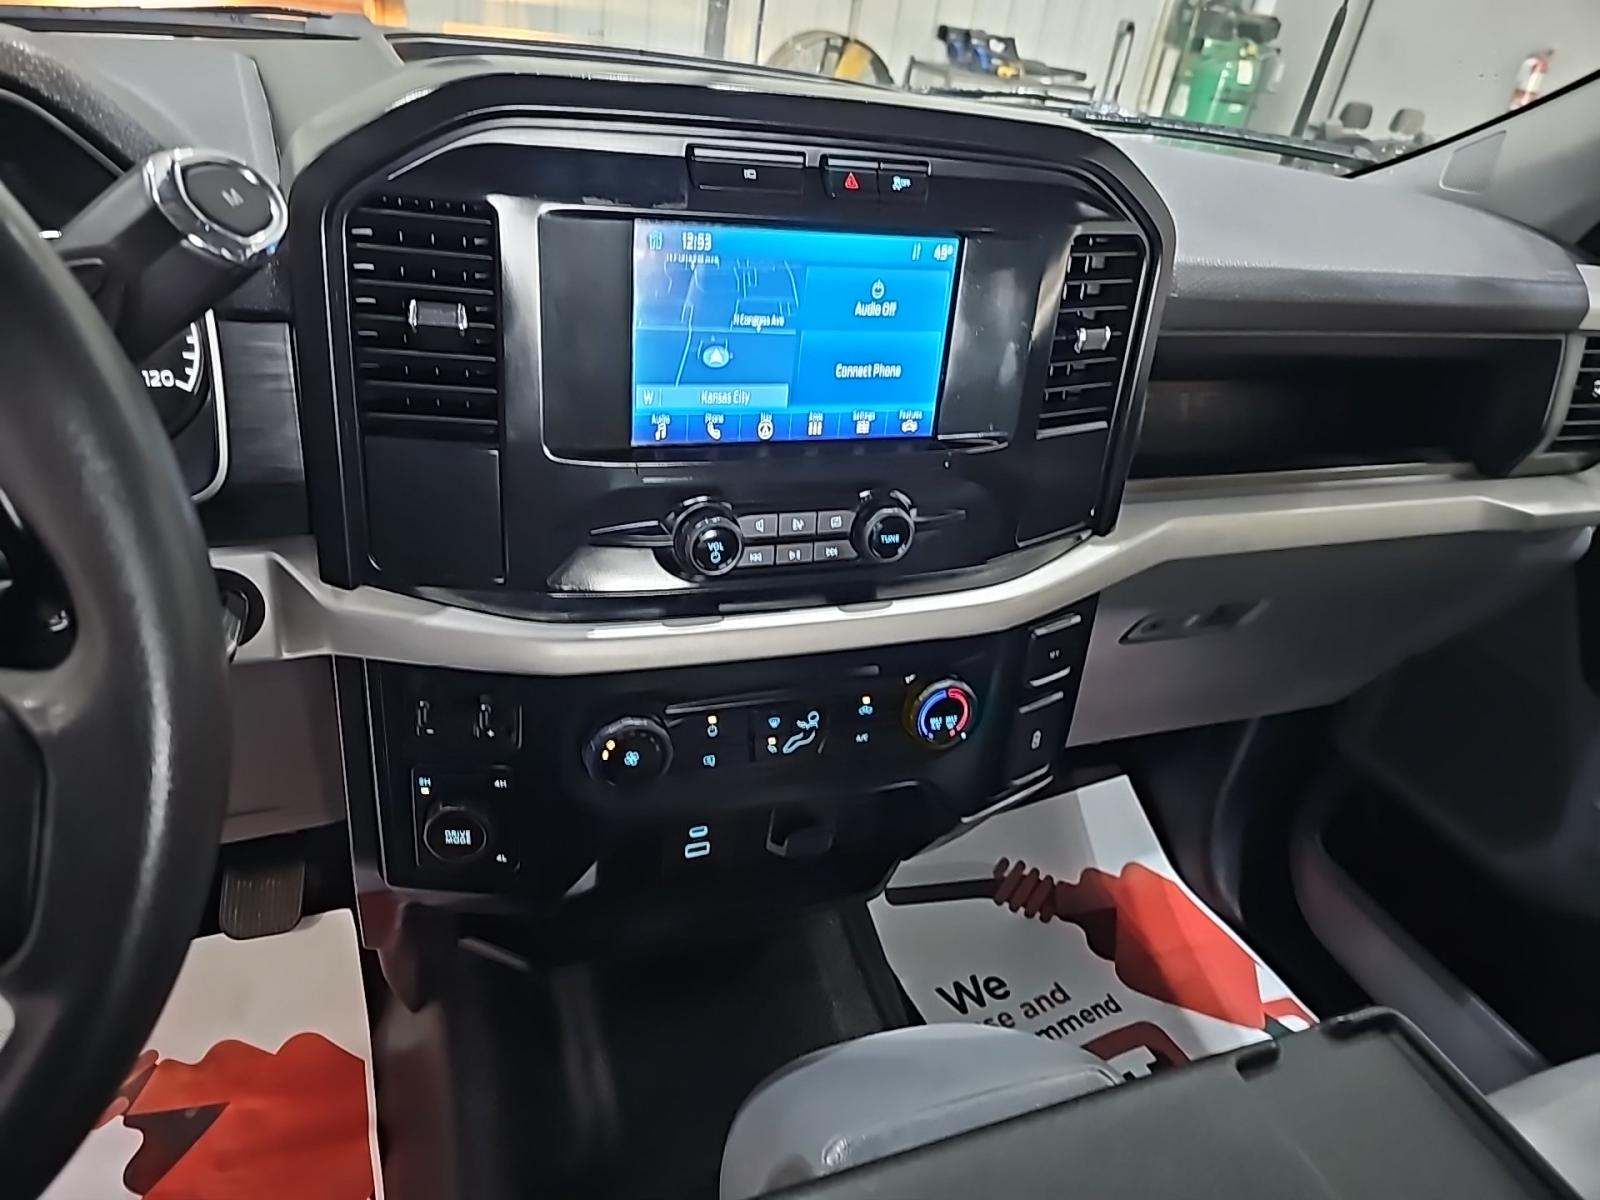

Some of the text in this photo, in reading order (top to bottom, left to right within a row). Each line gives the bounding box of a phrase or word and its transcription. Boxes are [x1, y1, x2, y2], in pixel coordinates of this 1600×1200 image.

[221, 188, 245, 208] M
[854, 301, 897, 317] Audio Off
[835, 363, 902, 378] Connect Phone
[141, 369, 176, 389] 120
[643, 390, 654, 405] W
[700, 389, 751, 406] Kansas City
[707, 541, 725, 552] VOL
[880, 533, 900, 544] TUNE
[935, 973, 1011, 1015] We
[1020, 981, 1072, 1020] and
